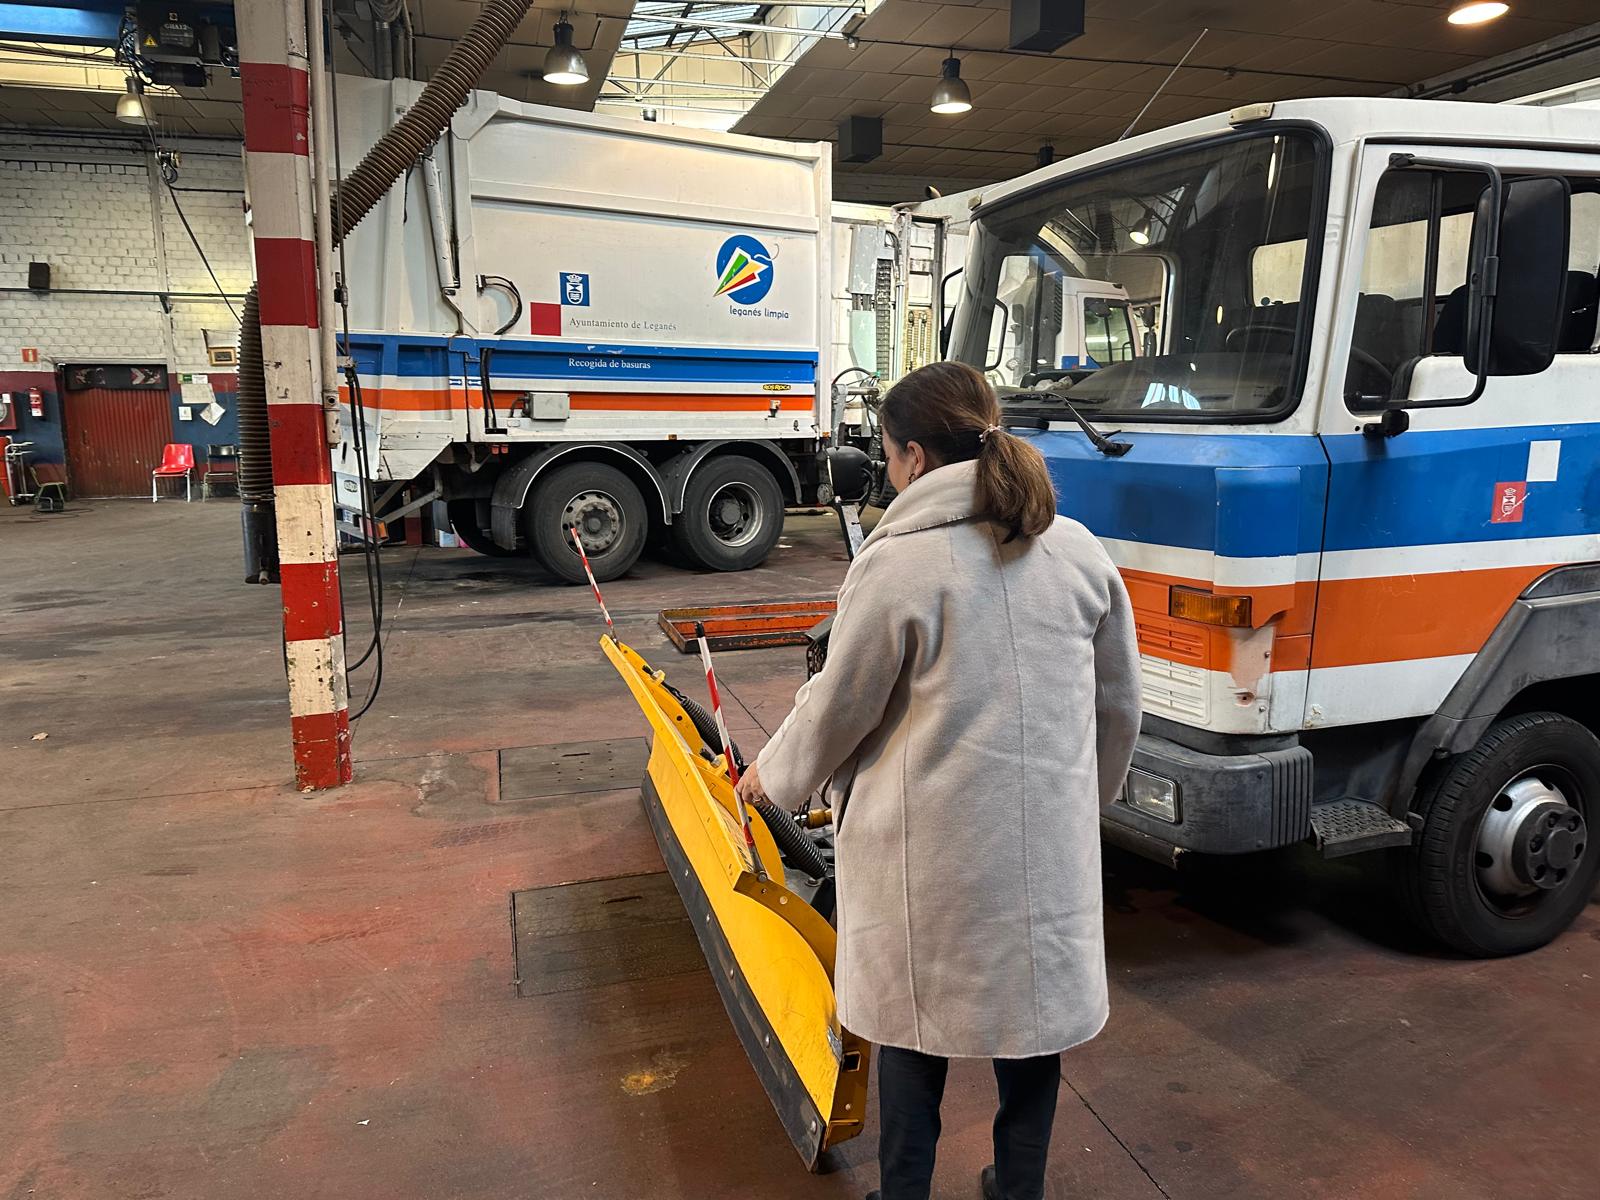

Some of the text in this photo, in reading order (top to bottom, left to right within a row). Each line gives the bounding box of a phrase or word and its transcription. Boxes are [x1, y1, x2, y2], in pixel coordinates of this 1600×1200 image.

[729, 305, 789, 320] leganés limpia
[569, 317, 677, 331] Ayuntamiento de Leganés
[568, 358, 651, 370] Recogida de basuras
